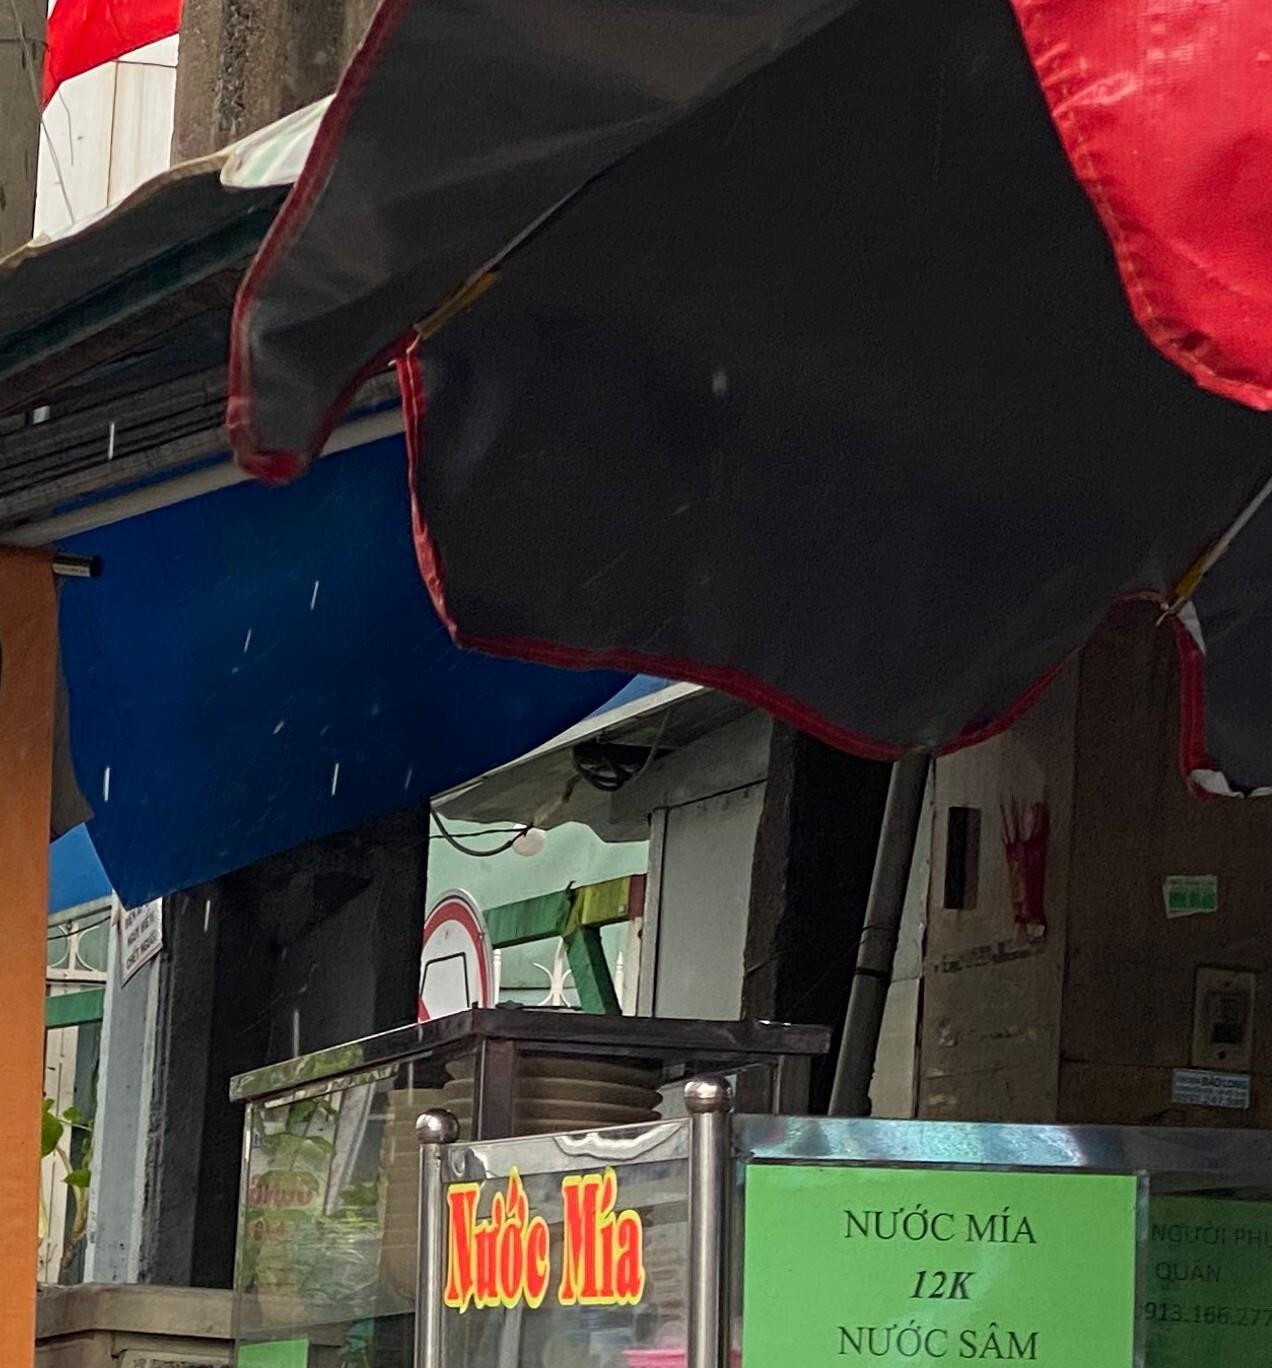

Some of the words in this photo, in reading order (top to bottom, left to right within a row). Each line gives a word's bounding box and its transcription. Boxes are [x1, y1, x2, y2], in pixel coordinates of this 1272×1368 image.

[444, 1166, 551, 1314] Nước
[559, 1166, 646, 1306] Mía
[844, 1206, 954, 1242] NƯỚC
[966, 1206, 1036, 1244] MÍA
[910, 1269, 973, 1299] 12K
[838, 1319, 947, 1358] NƯỚC
[959, 1320, 1038, 1360] SÂM
